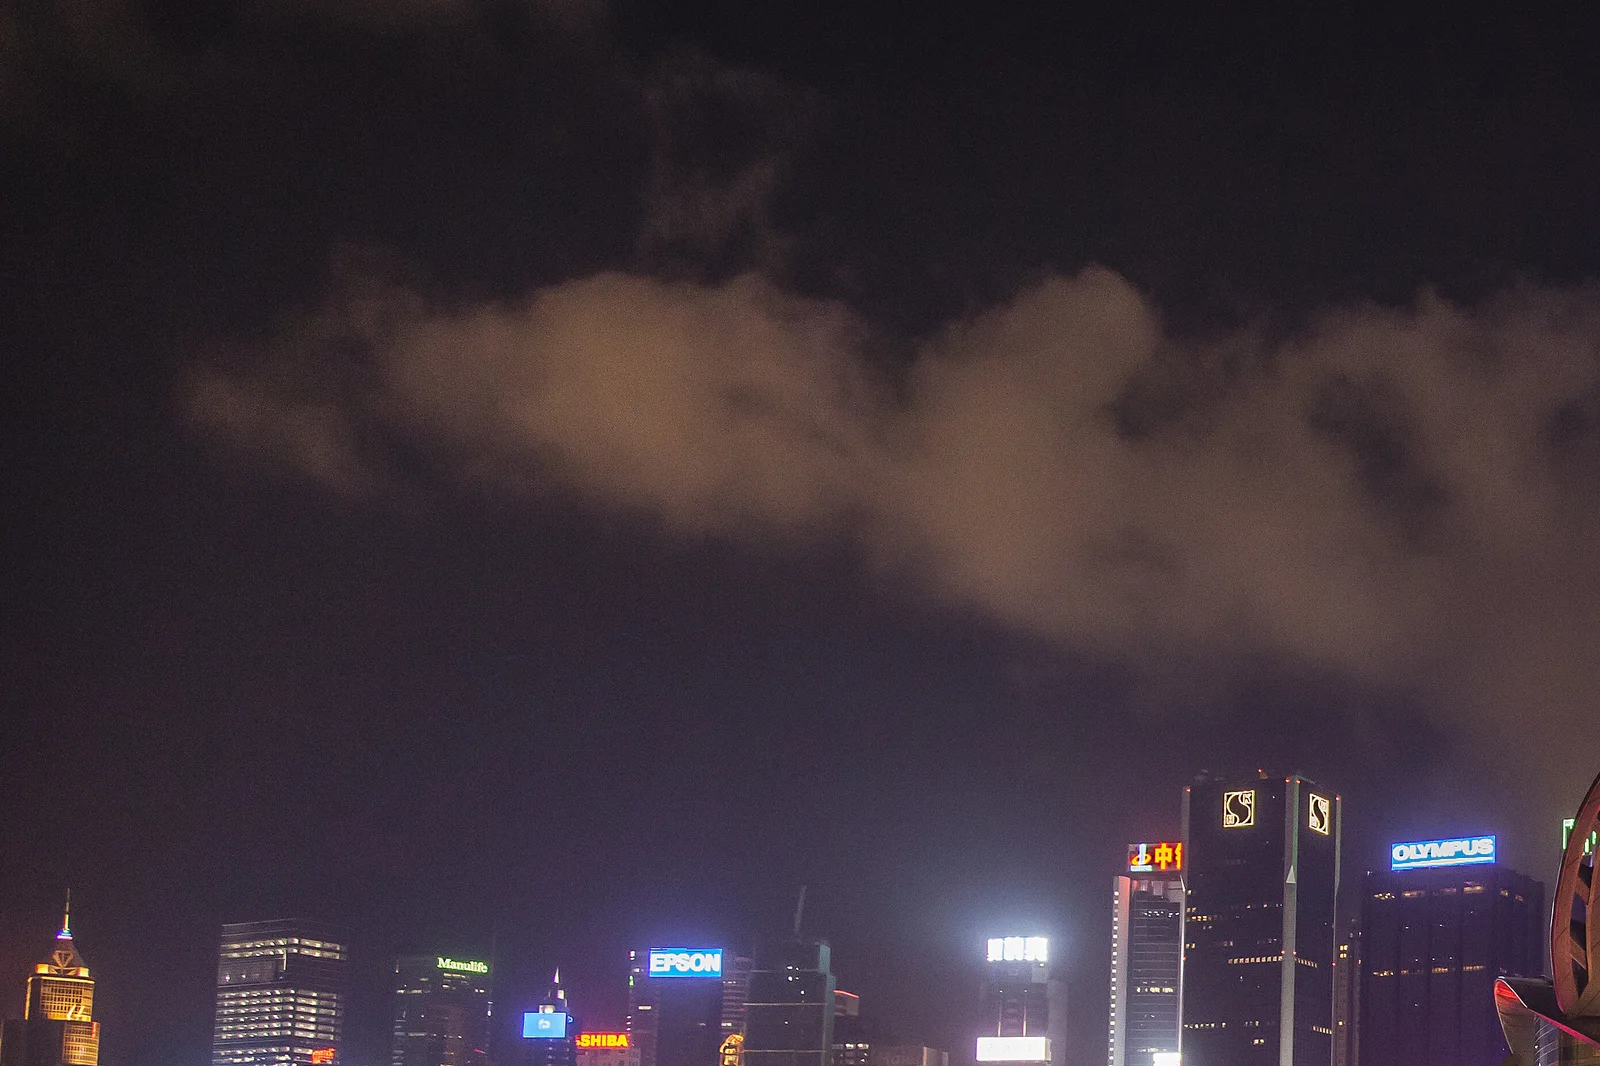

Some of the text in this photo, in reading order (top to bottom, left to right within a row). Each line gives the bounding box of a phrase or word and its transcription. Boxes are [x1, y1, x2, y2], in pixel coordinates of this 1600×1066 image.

[1392, 838, 1494, 861] OLYMPUS
[437, 957, 488, 973] Manulife
[650, 953, 720, 972] EPSON
[576, 1034, 628, 1048] SHIBA
